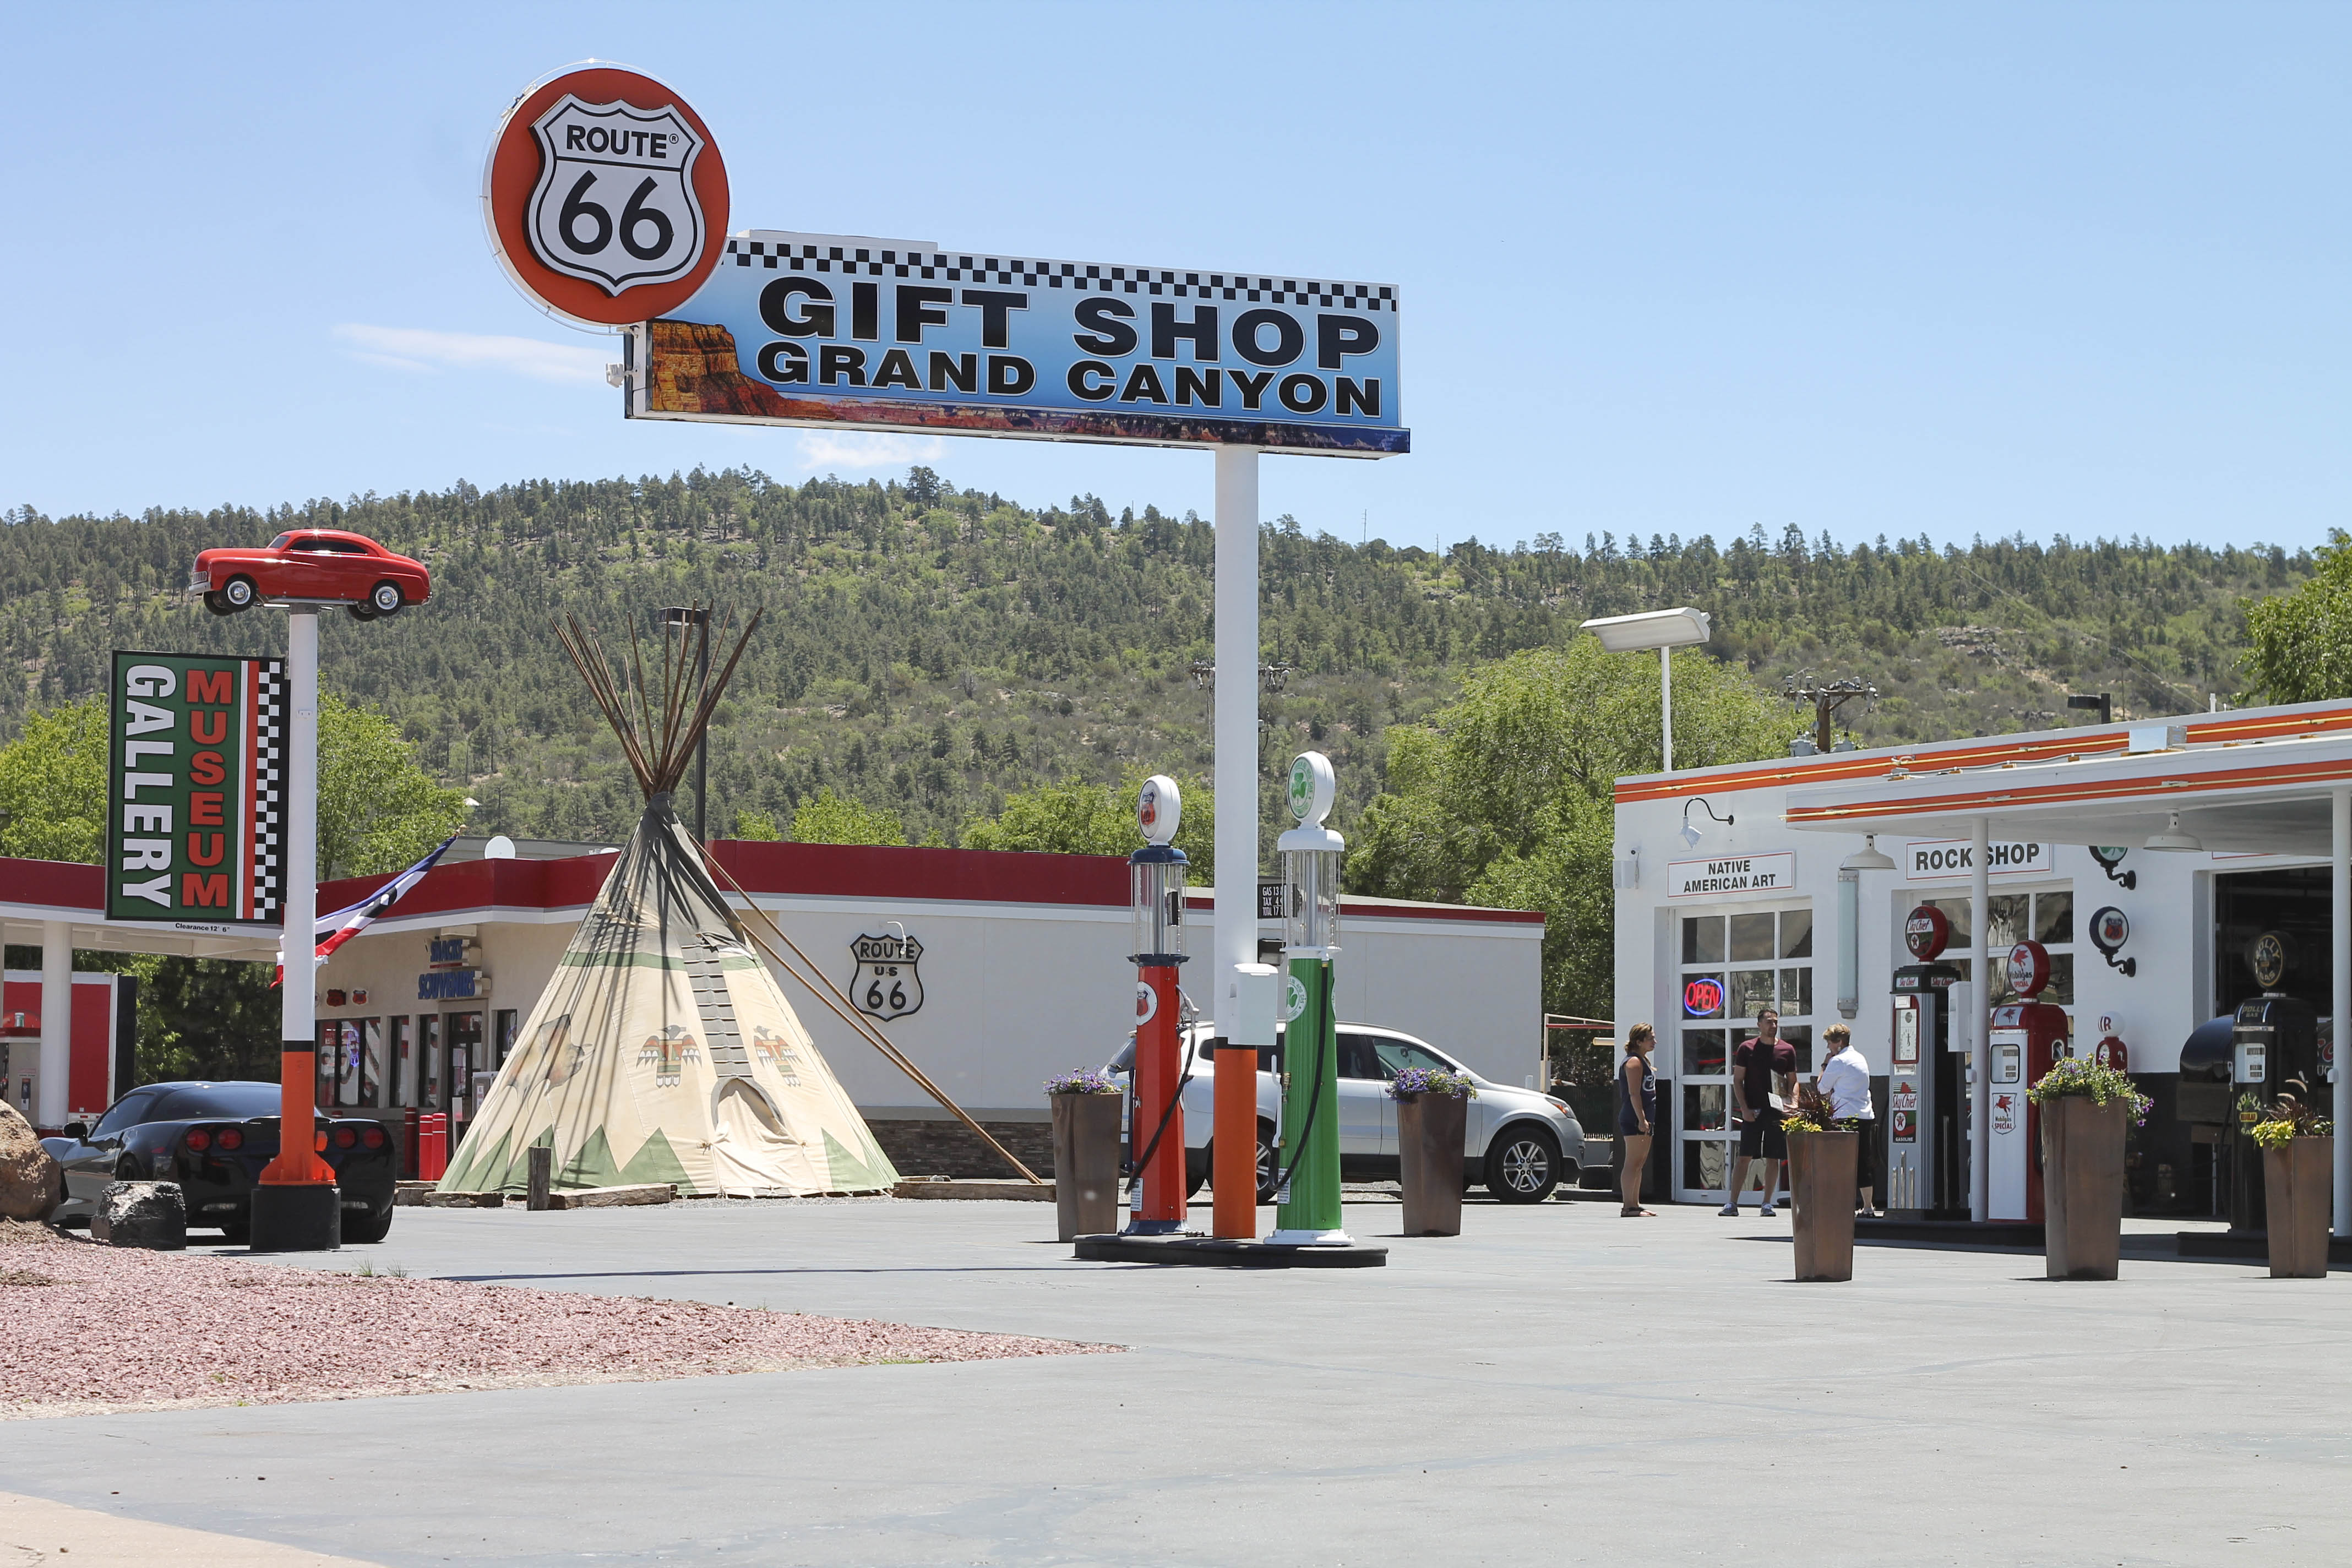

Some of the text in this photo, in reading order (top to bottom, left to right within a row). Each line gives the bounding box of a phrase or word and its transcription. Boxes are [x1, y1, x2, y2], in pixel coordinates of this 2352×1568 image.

[559, 170, 674, 261] 66
[758, 276, 1381, 372] GIFT SHOP
[757, 341, 1381, 418] GRAND CANYON
[122, 665, 177, 909] GALLERY
[182, 669, 233, 907] MUSEUM
[1708, 860, 1751, 875] NATIVE
[1916, 847, 1972, 871] ROCK
[1262, 886, 1279, 896] GAS 13
[1683, 874, 1776, 893] AMERICAN ART
[1262, 897, 1272, 906] TAX
[1262, 906, 1279, 916] TOTAL 17
[175, 923, 209, 931] Clearance
[430, 938, 463, 962] SNACKS
[859, 942, 915, 959] ROUTE
[2255, 939, 2280, 960] POLLY
[874, 966, 898, 977] US
[418, 970, 475, 1000] SOUVENIRS
[866, 979, 907, 1010] 66
[1685, 982, 1719, 1010] OPEN
[1892, 1093, 1916, 1110] Sky Chief
